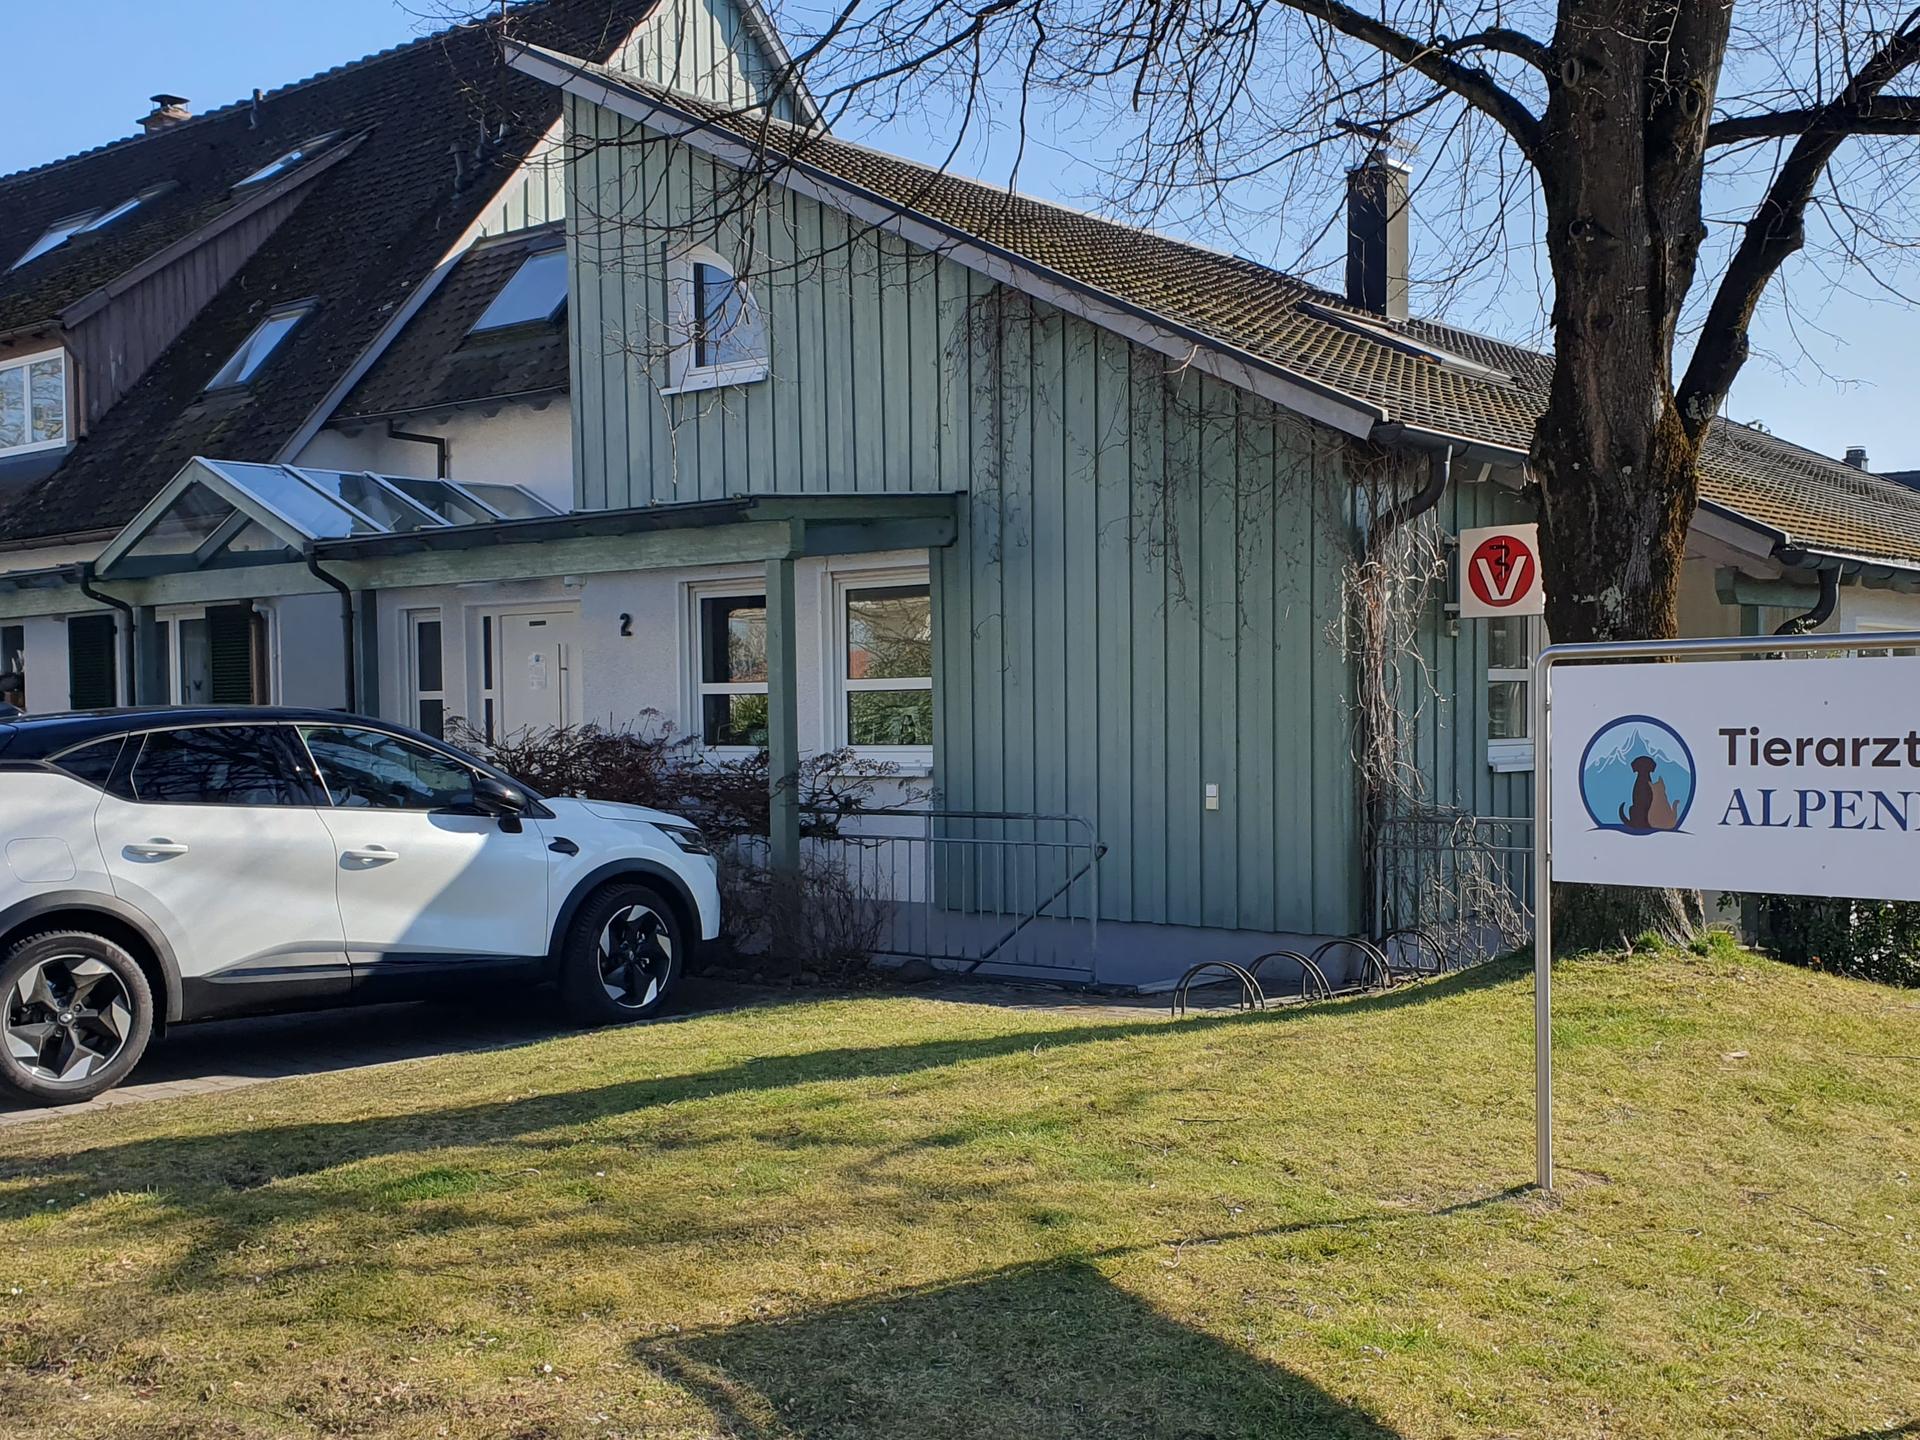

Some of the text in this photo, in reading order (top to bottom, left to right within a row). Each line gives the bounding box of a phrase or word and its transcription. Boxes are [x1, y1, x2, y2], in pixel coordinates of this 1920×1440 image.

[1476, 555, 1527, 601] V
[620, 612, 632, 637] 2
[1718, 726, 1920, 768] Tierarzt
[1717, 788, 1920, 832] ALPEN
